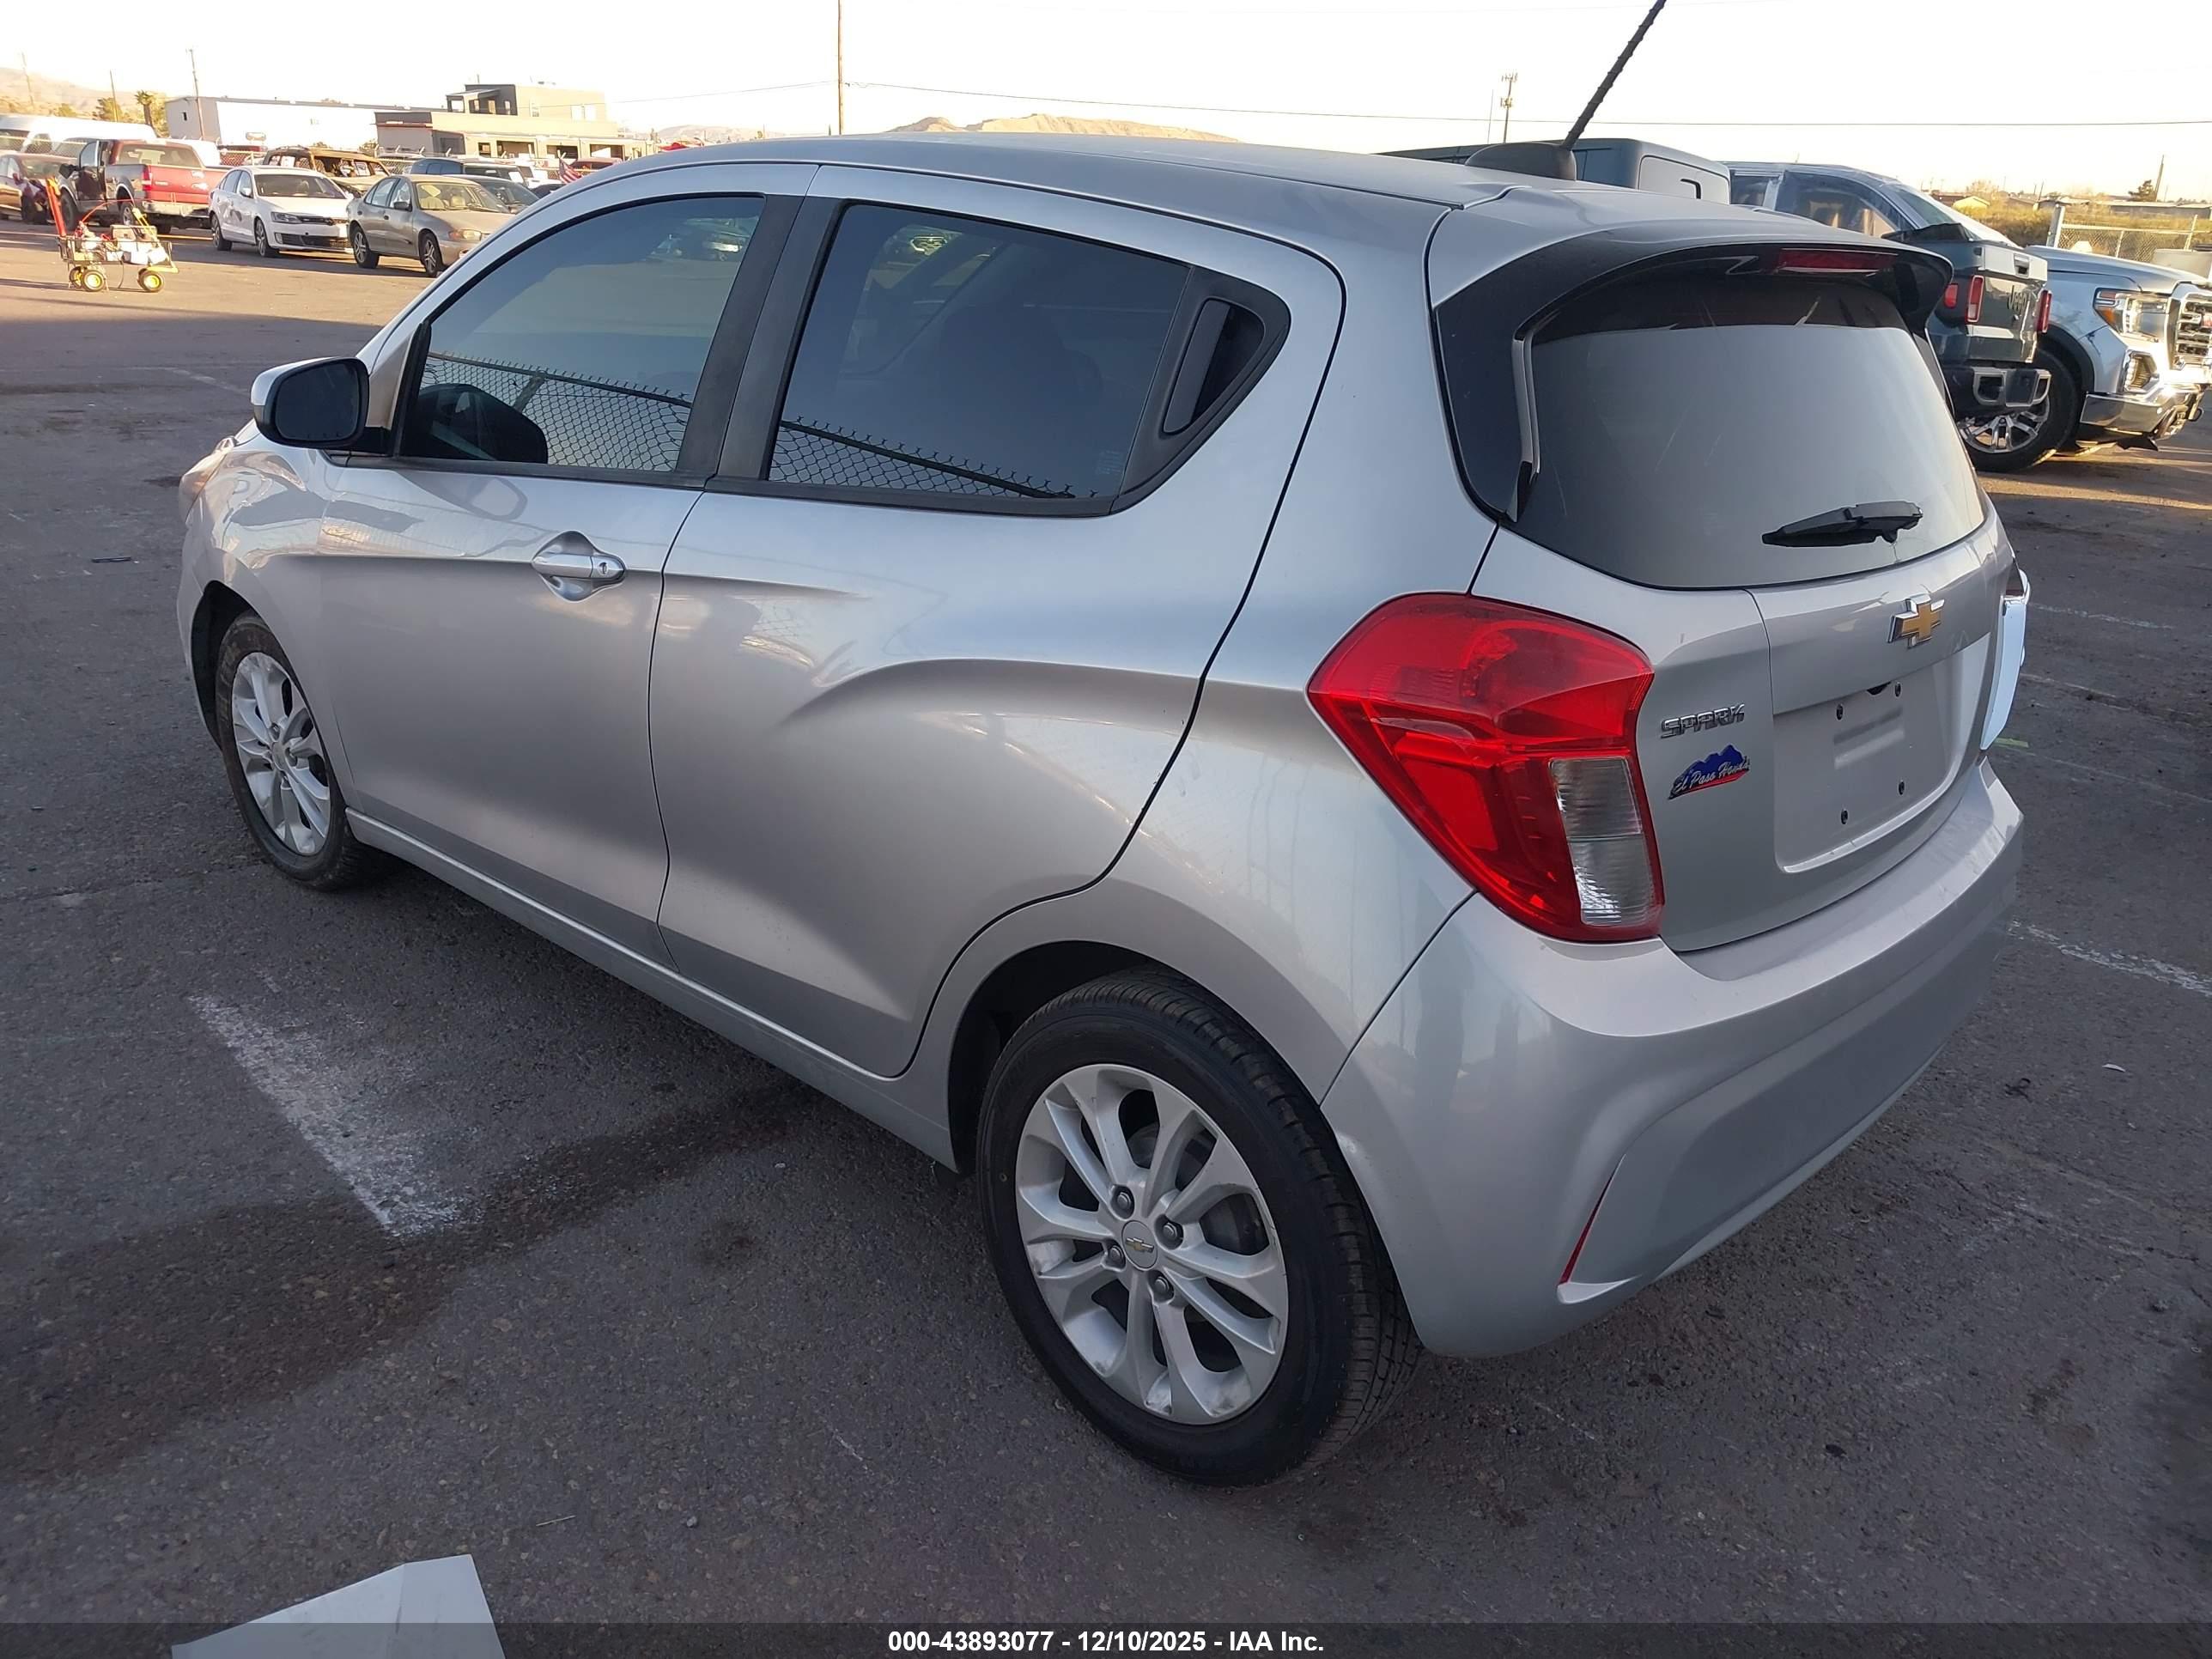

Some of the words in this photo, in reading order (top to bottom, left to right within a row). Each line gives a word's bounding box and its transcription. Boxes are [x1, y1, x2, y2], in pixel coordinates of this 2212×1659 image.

[1660, 703, 1745, 738] SPARK
[1674, 775, 1687, 792] El
[1689, 769, 1717, 788] Paso
